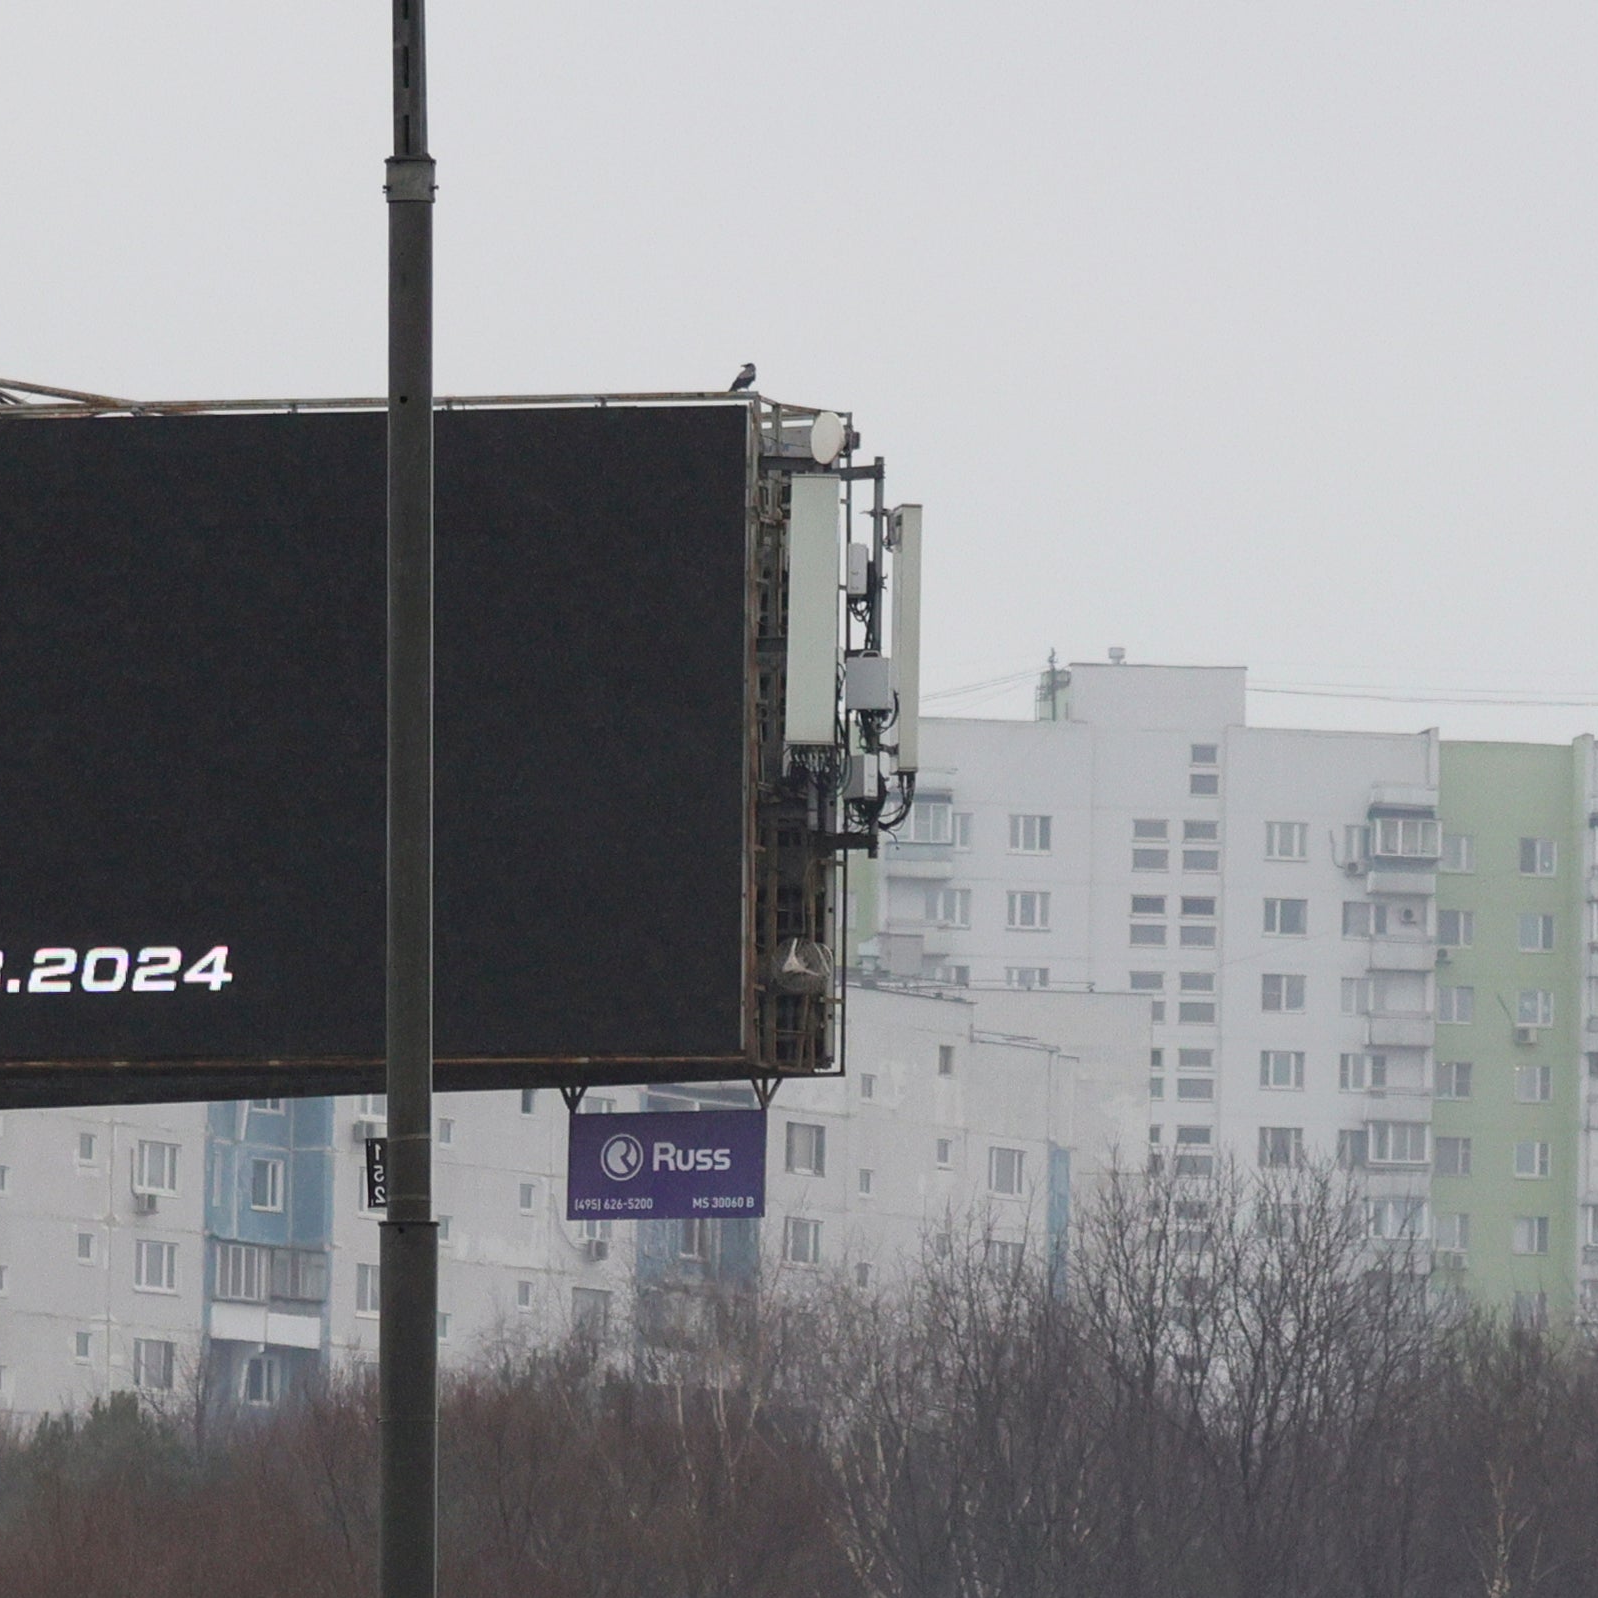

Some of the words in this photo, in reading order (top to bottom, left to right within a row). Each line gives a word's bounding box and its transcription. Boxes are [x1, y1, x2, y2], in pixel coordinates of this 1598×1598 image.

[652, 1142, 732, 1172] Russ
[603, 1198, 653, 1210] 626-5200
[692, 1197, 709, 1209] MS
